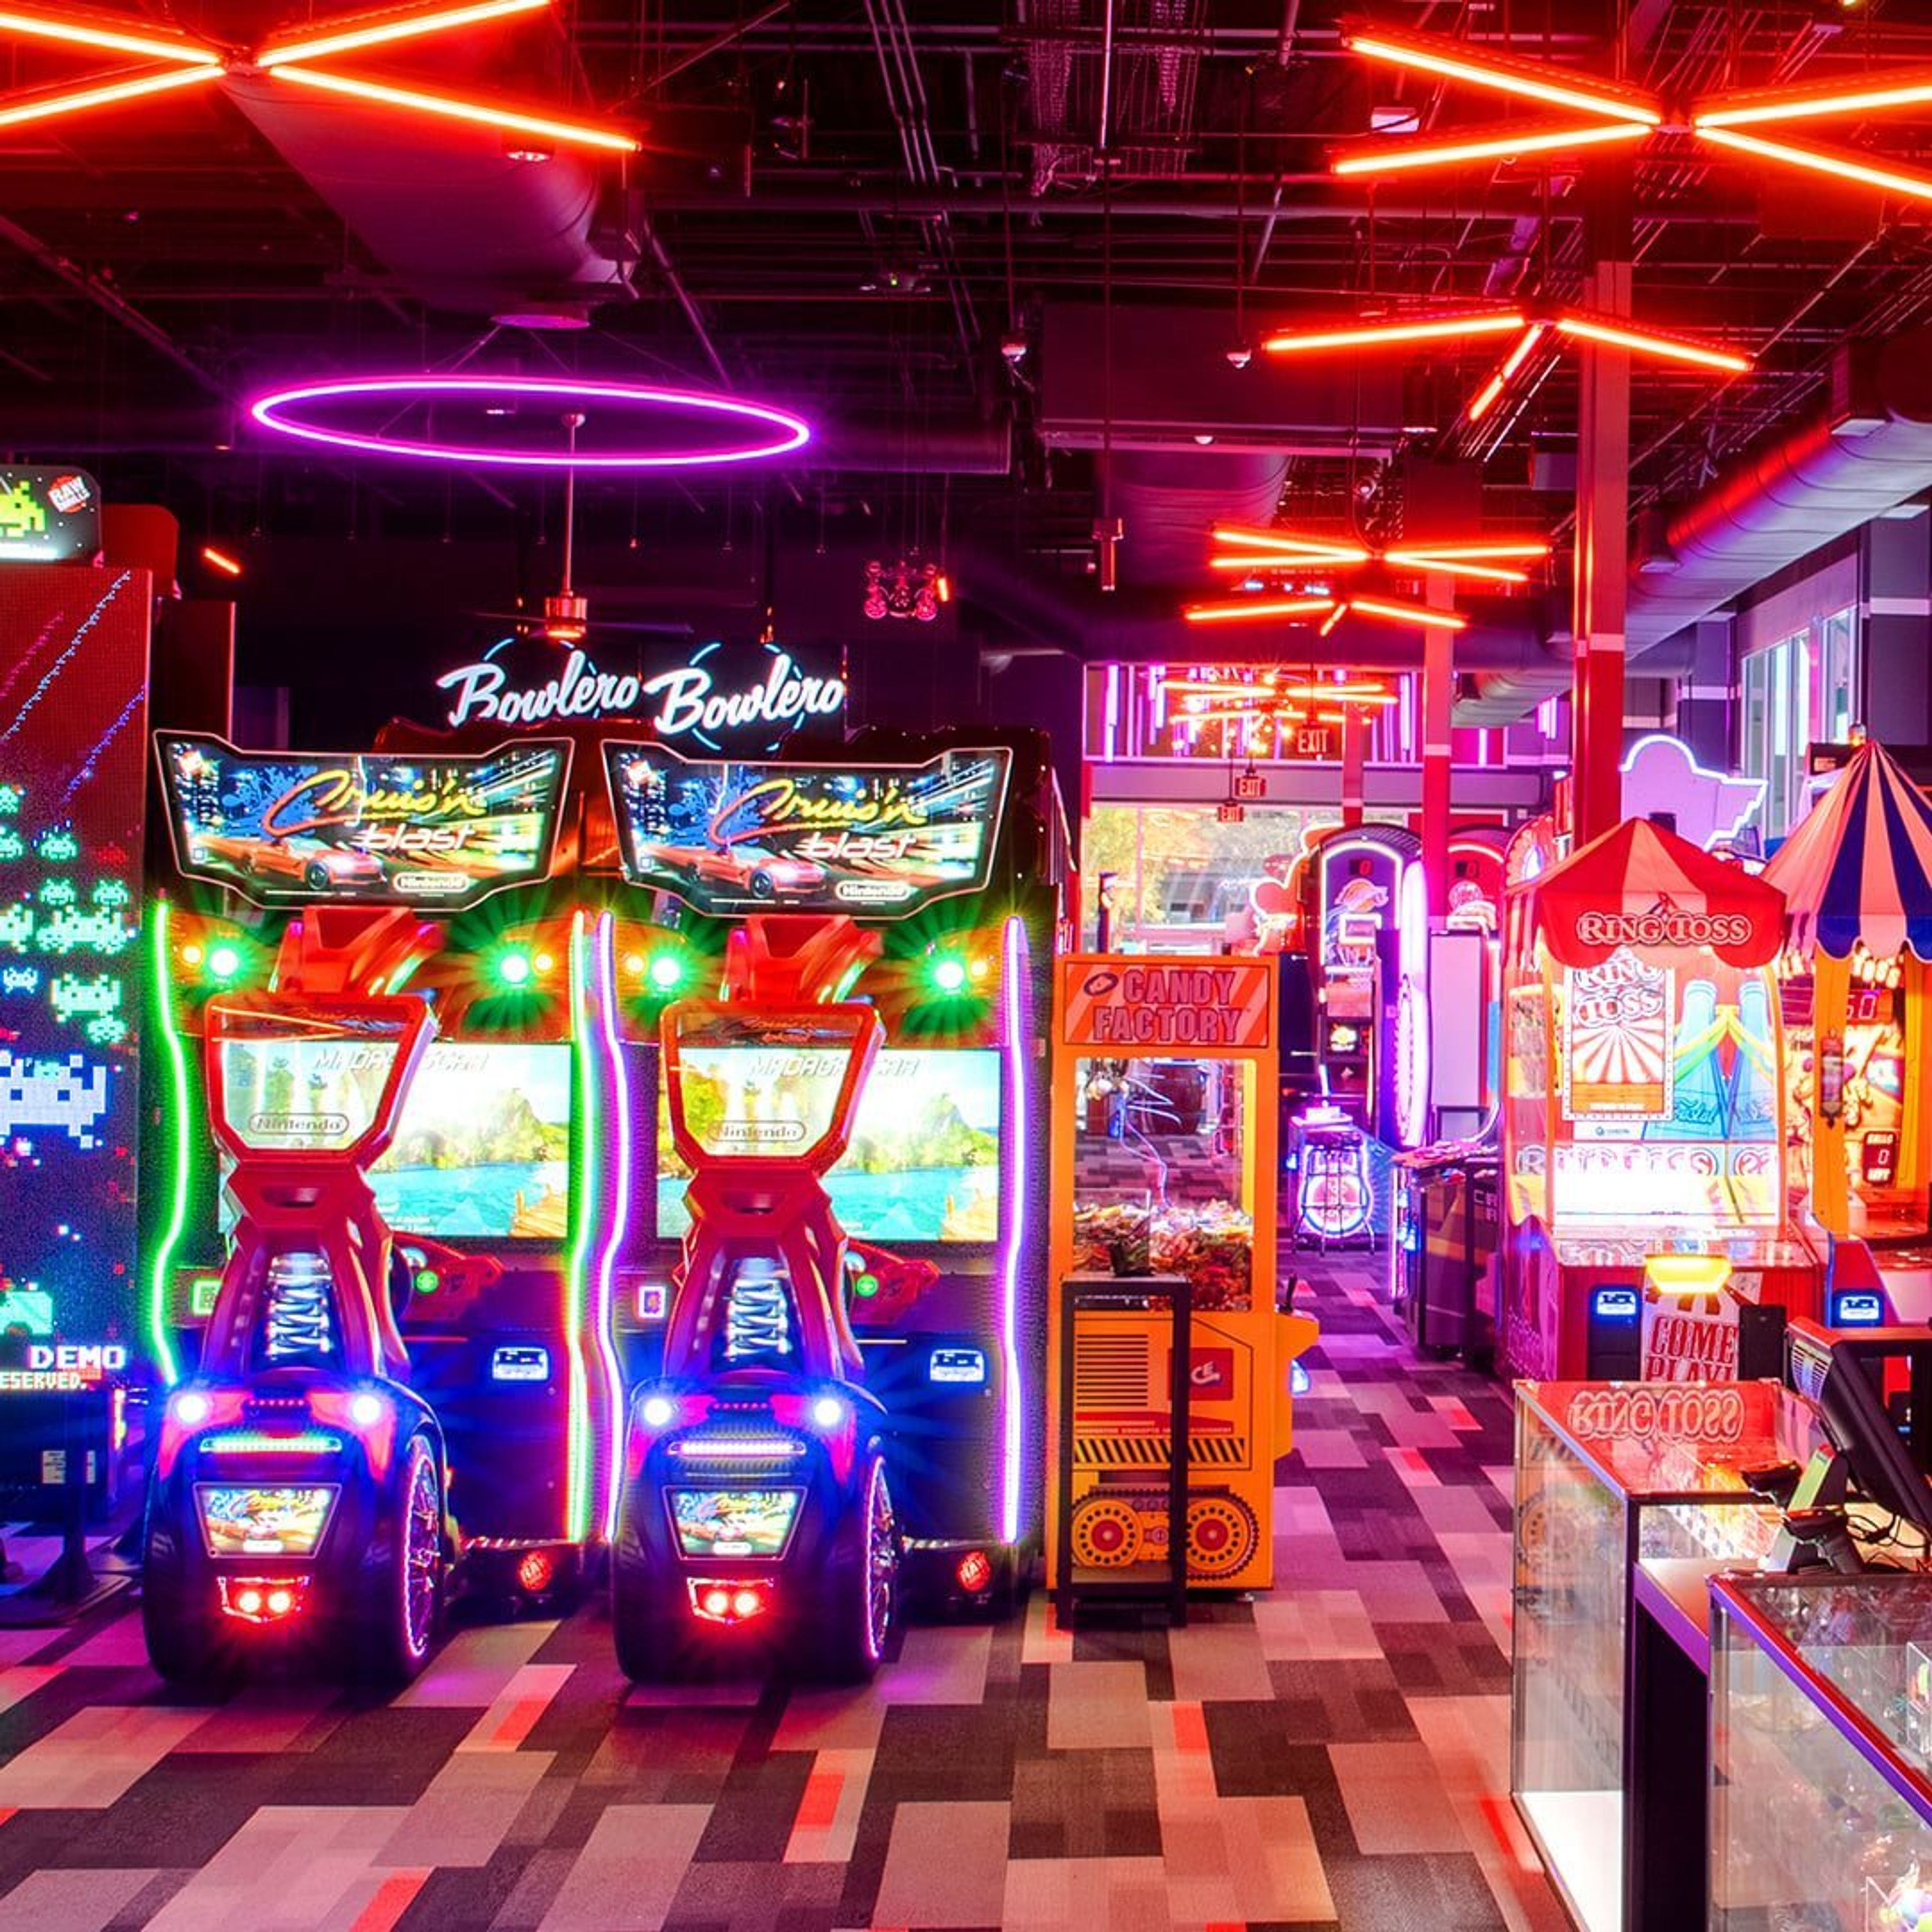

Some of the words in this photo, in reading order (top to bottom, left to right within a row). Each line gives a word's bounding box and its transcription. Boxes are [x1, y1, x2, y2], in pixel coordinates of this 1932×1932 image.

[1299, 730, 1328, 752] EXIT
[262, 769, 487, 837] Cruis'n
[1239, 780, 1261, 796] EXIT
[708, 779, 927, 845] Cruis'n
[353, 823, 475, 850] blast
[796, 832, 917, 858] blast
[1579, 914, 1663, 943] RING
[1669, 914, 1749, 943] TOSS
[1123, 970, 1236, 1005] CANDY
[1578, 957, 1663, 990] RING
[1577, 990, 1664, 1025] TOSS
[1094, 1007, 1242, 1042] FACTORY
[1878, 1150, 1890, 1164] 0
[1650, 1317, 1738, 1363] COME
[30, 1345, 126, 1369] DEMO
